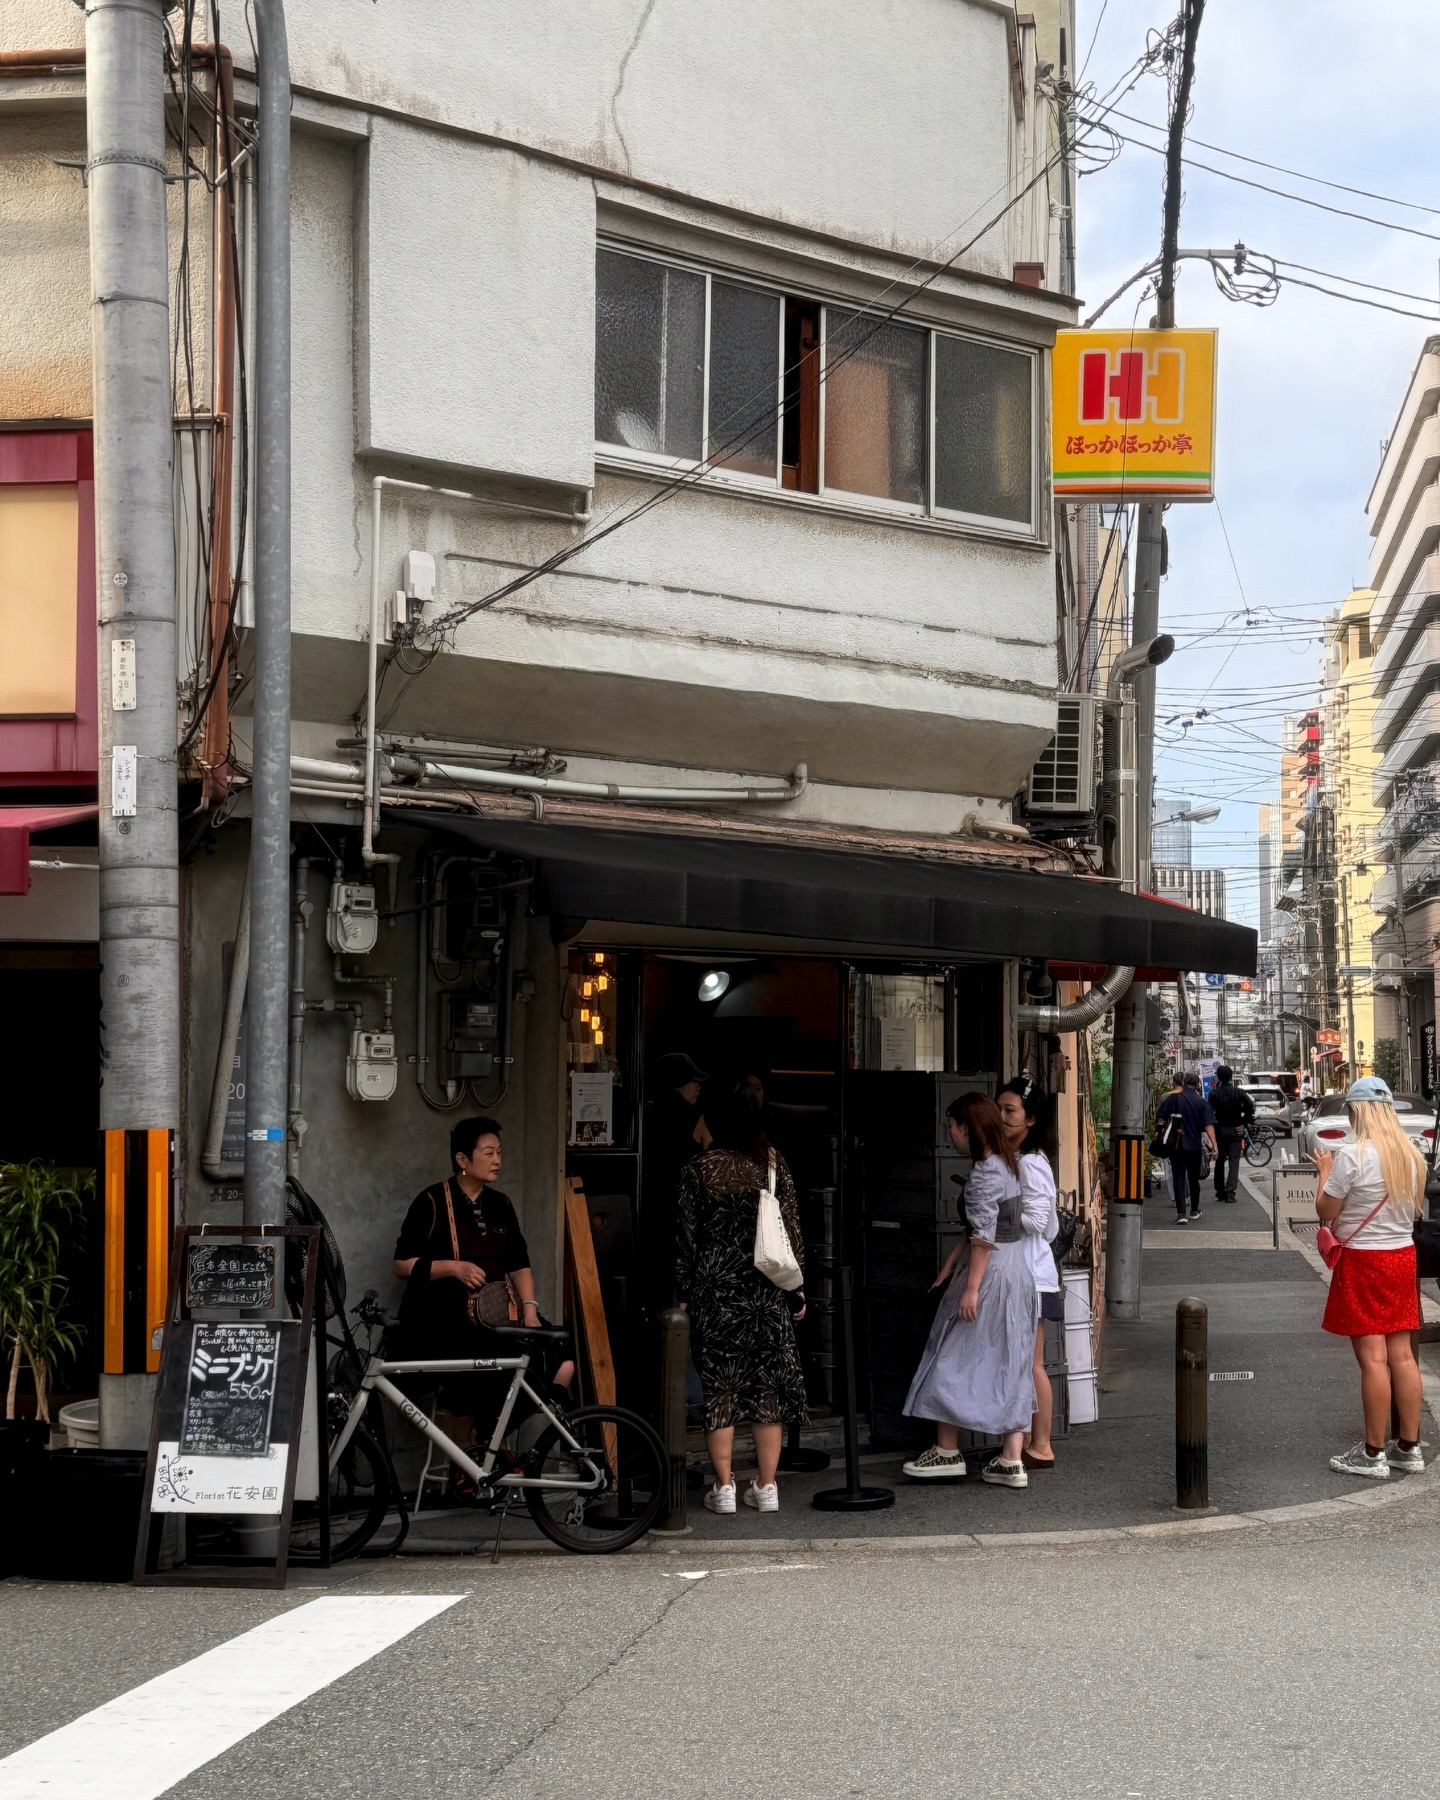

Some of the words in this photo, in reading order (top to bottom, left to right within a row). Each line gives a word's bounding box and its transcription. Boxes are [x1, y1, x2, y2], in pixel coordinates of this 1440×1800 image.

[1065, 433, 1193, 455] ほっかほっか亭
[1286, 1189, 1315, 1199] JULIAN
[191, 1348, 274, 1385] ミニブーケ
[195, 1491, 225, 1500] Florist
[227, 1486, 278, 1500] 花安園
